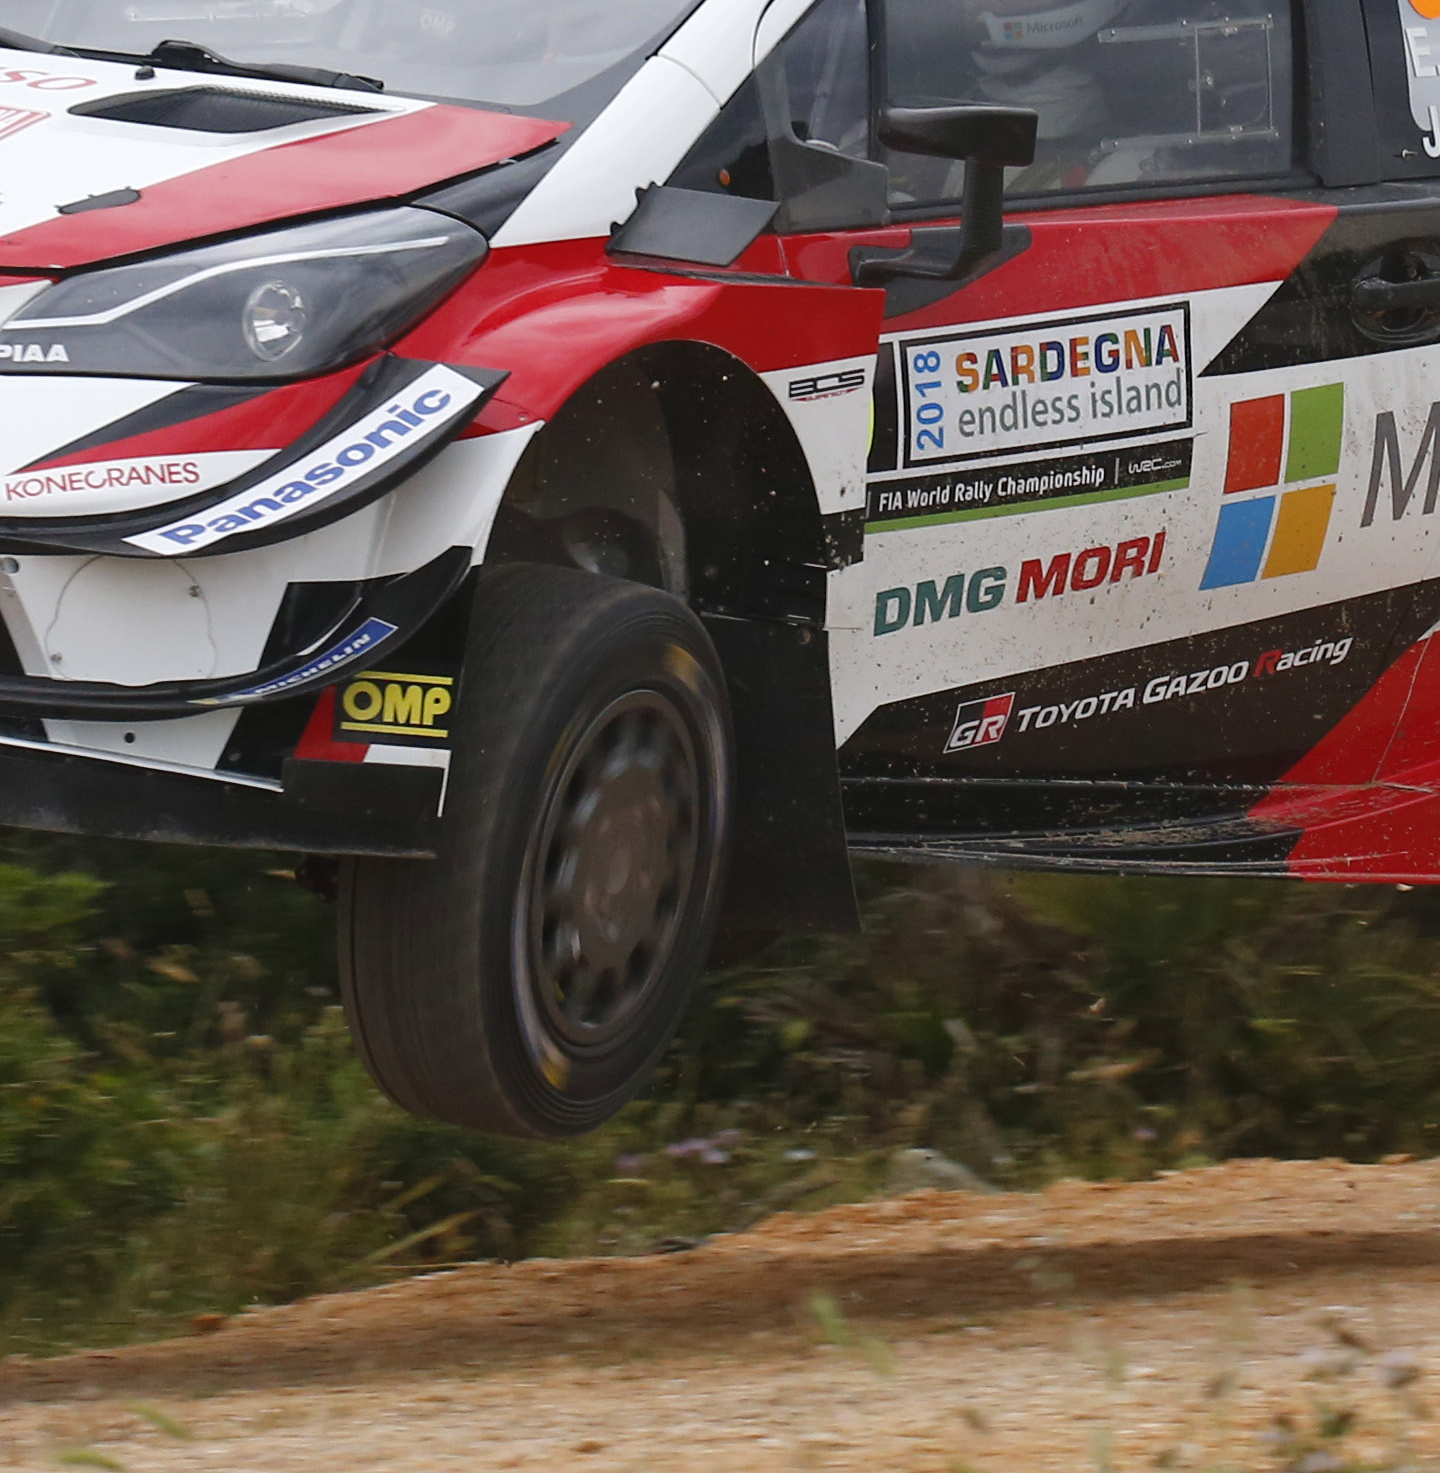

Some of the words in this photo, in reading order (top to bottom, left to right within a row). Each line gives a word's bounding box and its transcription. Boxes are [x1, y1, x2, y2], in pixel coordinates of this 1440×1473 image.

[1026, 15, 1084, 35] Microsoft
[954, 324, 1180, 394] SARDEGNA
[915, 349, 945, 451] 2018
[958, 389, 1081, 438] endless
[1088, 367, 1183, 422] island
[5, 461, 200, 501] KONECRANES
[155, 388, 453, 546] Panasonic
[878, 490, 903, 512] FIA
[907, 484, 950, 510] World
[954, 476, 993, 503] Rally
[997, 465, 1105, 498] Championship
[873, 565, 1007, 637] DMG
[1015, 531, 1167, 604] MORI
[251, 633, 372, 695] MICHELIN
[948, 711, 1008, 747] GR
[1016, 687, 1135, 734] TOYOTA
[1143, 659, 1249, 707] GAZOO
[1254, 635, 1354, 679] Racing
[342, 682, 452, 726] OMP
